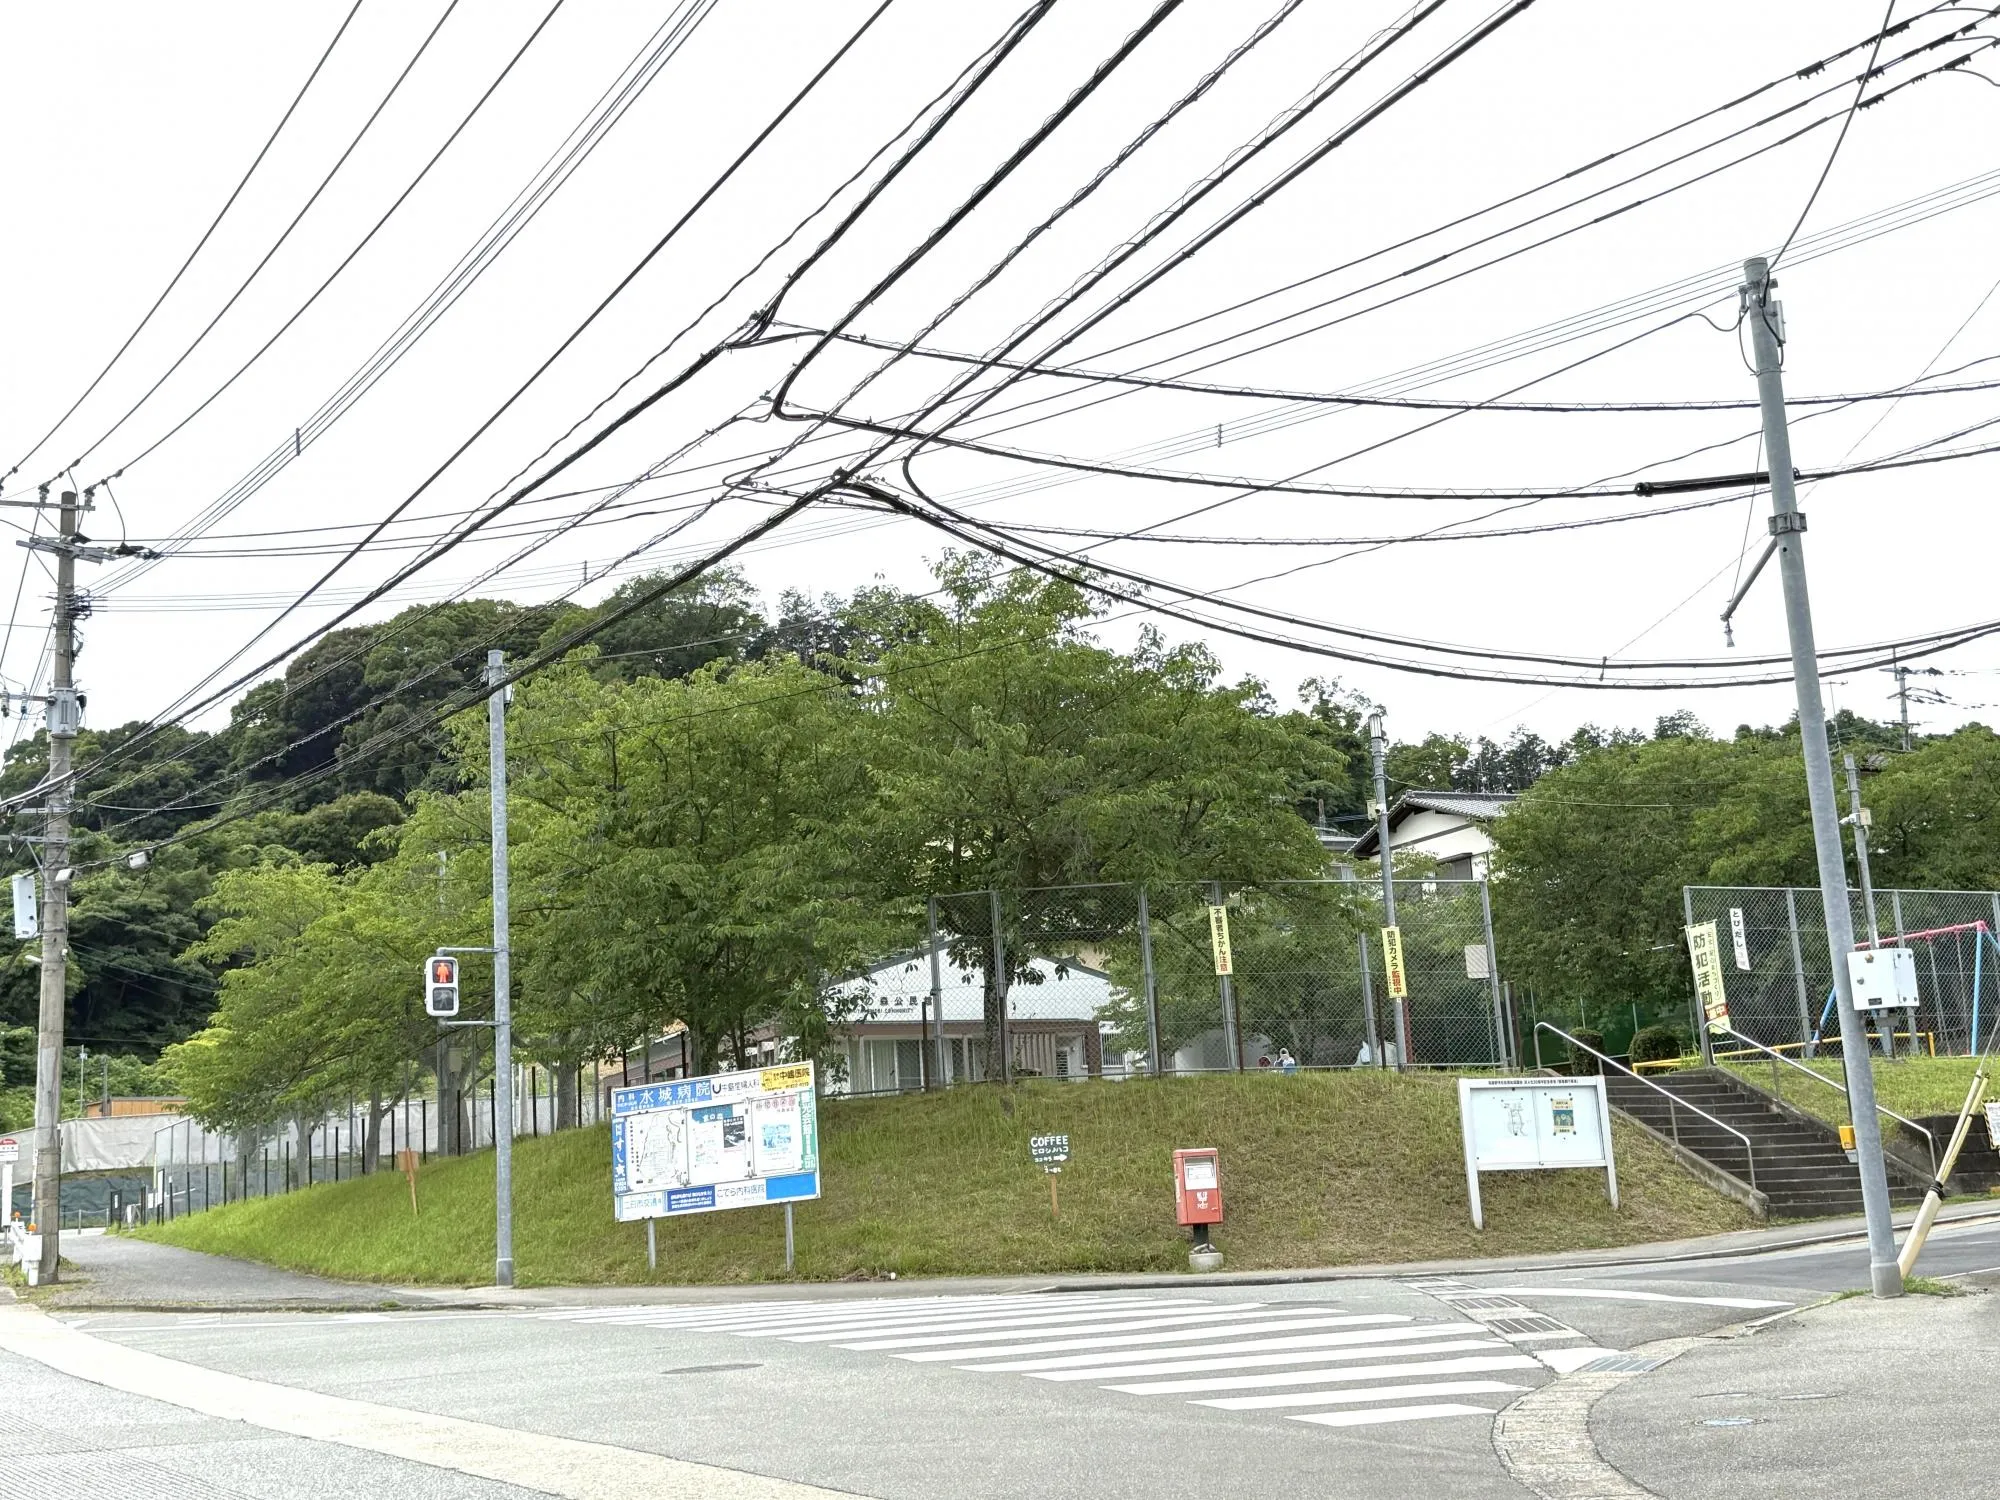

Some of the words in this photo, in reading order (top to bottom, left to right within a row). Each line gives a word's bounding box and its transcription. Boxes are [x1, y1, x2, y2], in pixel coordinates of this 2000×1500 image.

[1387, 930, 1402, 995] 防犯カメラ監視中
[1693, 932, 1713, 1006] 防犯活動
[639, 1082, 711, 1105] 水城病院
[1030, 1135, 1069, 1148] COFFEE
